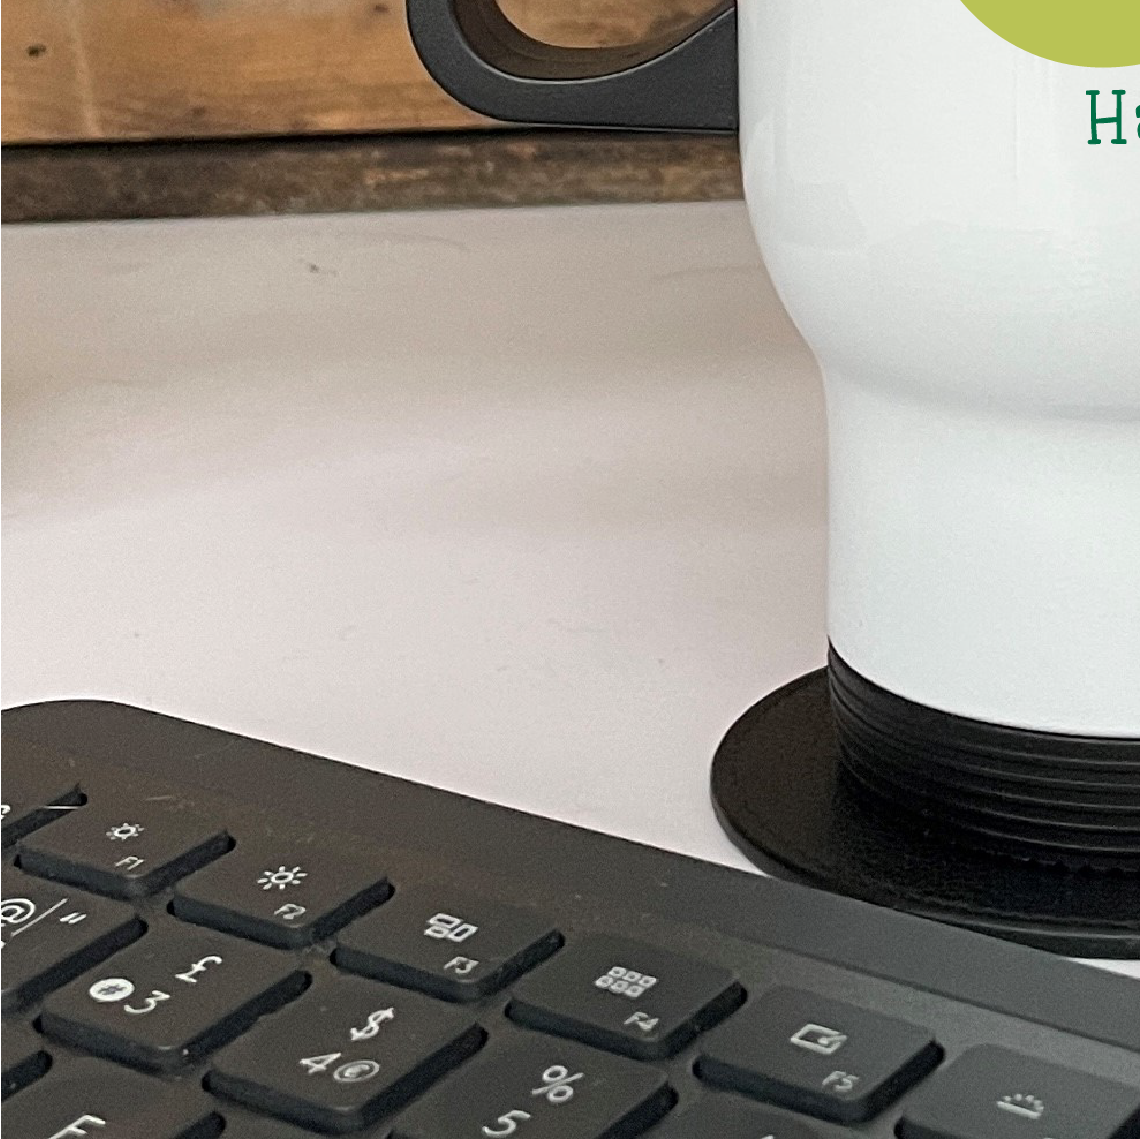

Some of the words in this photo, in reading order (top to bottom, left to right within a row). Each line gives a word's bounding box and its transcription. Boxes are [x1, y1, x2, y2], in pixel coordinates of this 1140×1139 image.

[273, 903, 306, 920] F2
[174, 955, 223, 983] £
[443, 956, 480, 974] F3
[123, 989, 171, 1014] 3
[350, 1007, 395, 1041] $
[623, 1011, 660, 1032] F4
[300, 1052, 342, 1074] 4
[531, 1064, 585, 1103] %
[822, 1070, 861, 1093] F5
[482, 1109, 532, 1138] 5
